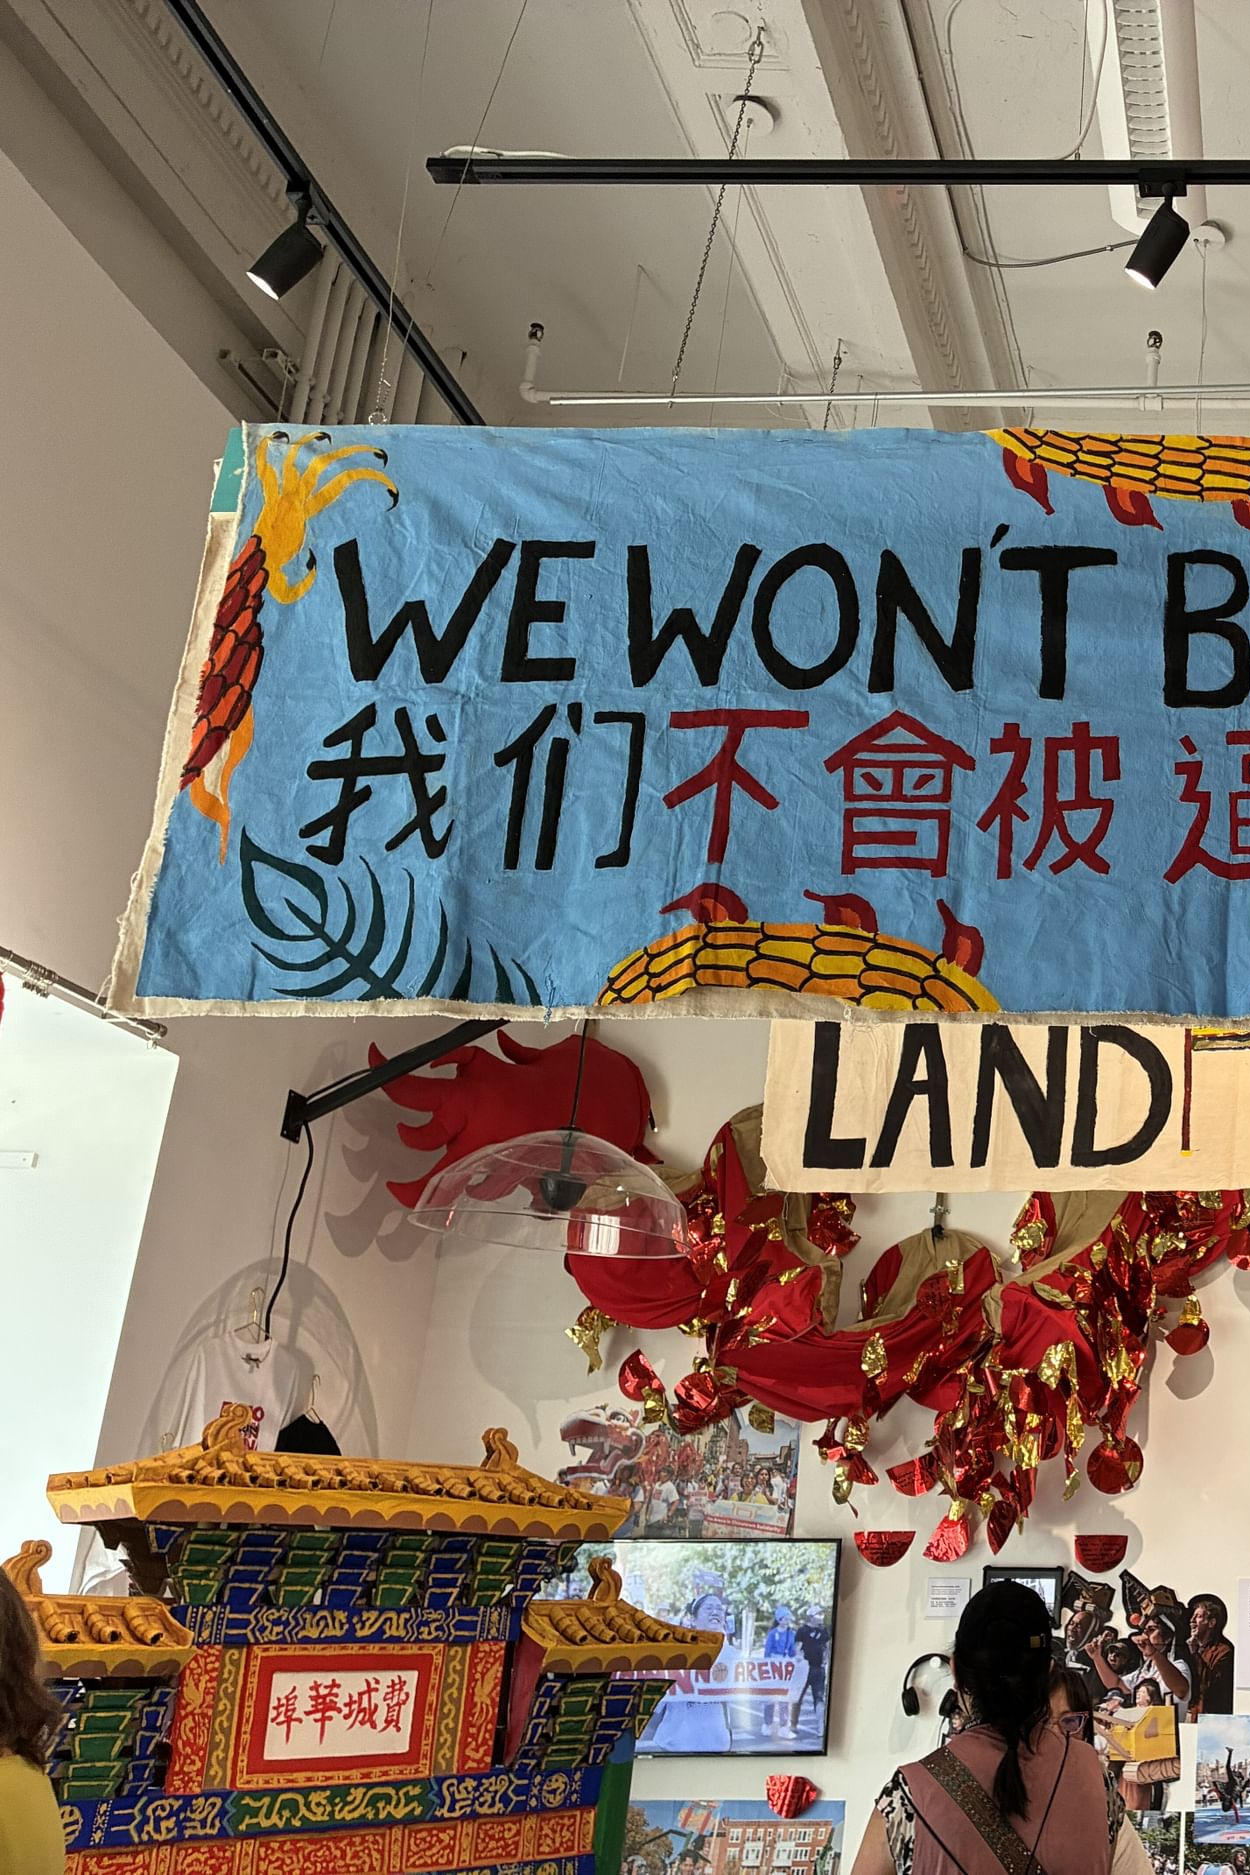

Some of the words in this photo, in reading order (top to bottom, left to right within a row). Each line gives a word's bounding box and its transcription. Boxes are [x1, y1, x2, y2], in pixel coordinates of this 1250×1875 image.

[333, 537, 599, 686] WE
[625, 524, 1118, 701] WON'T
[802, 1021, 1173, 1169] LAND
[734, 1660, 796, 1682] ARENA
